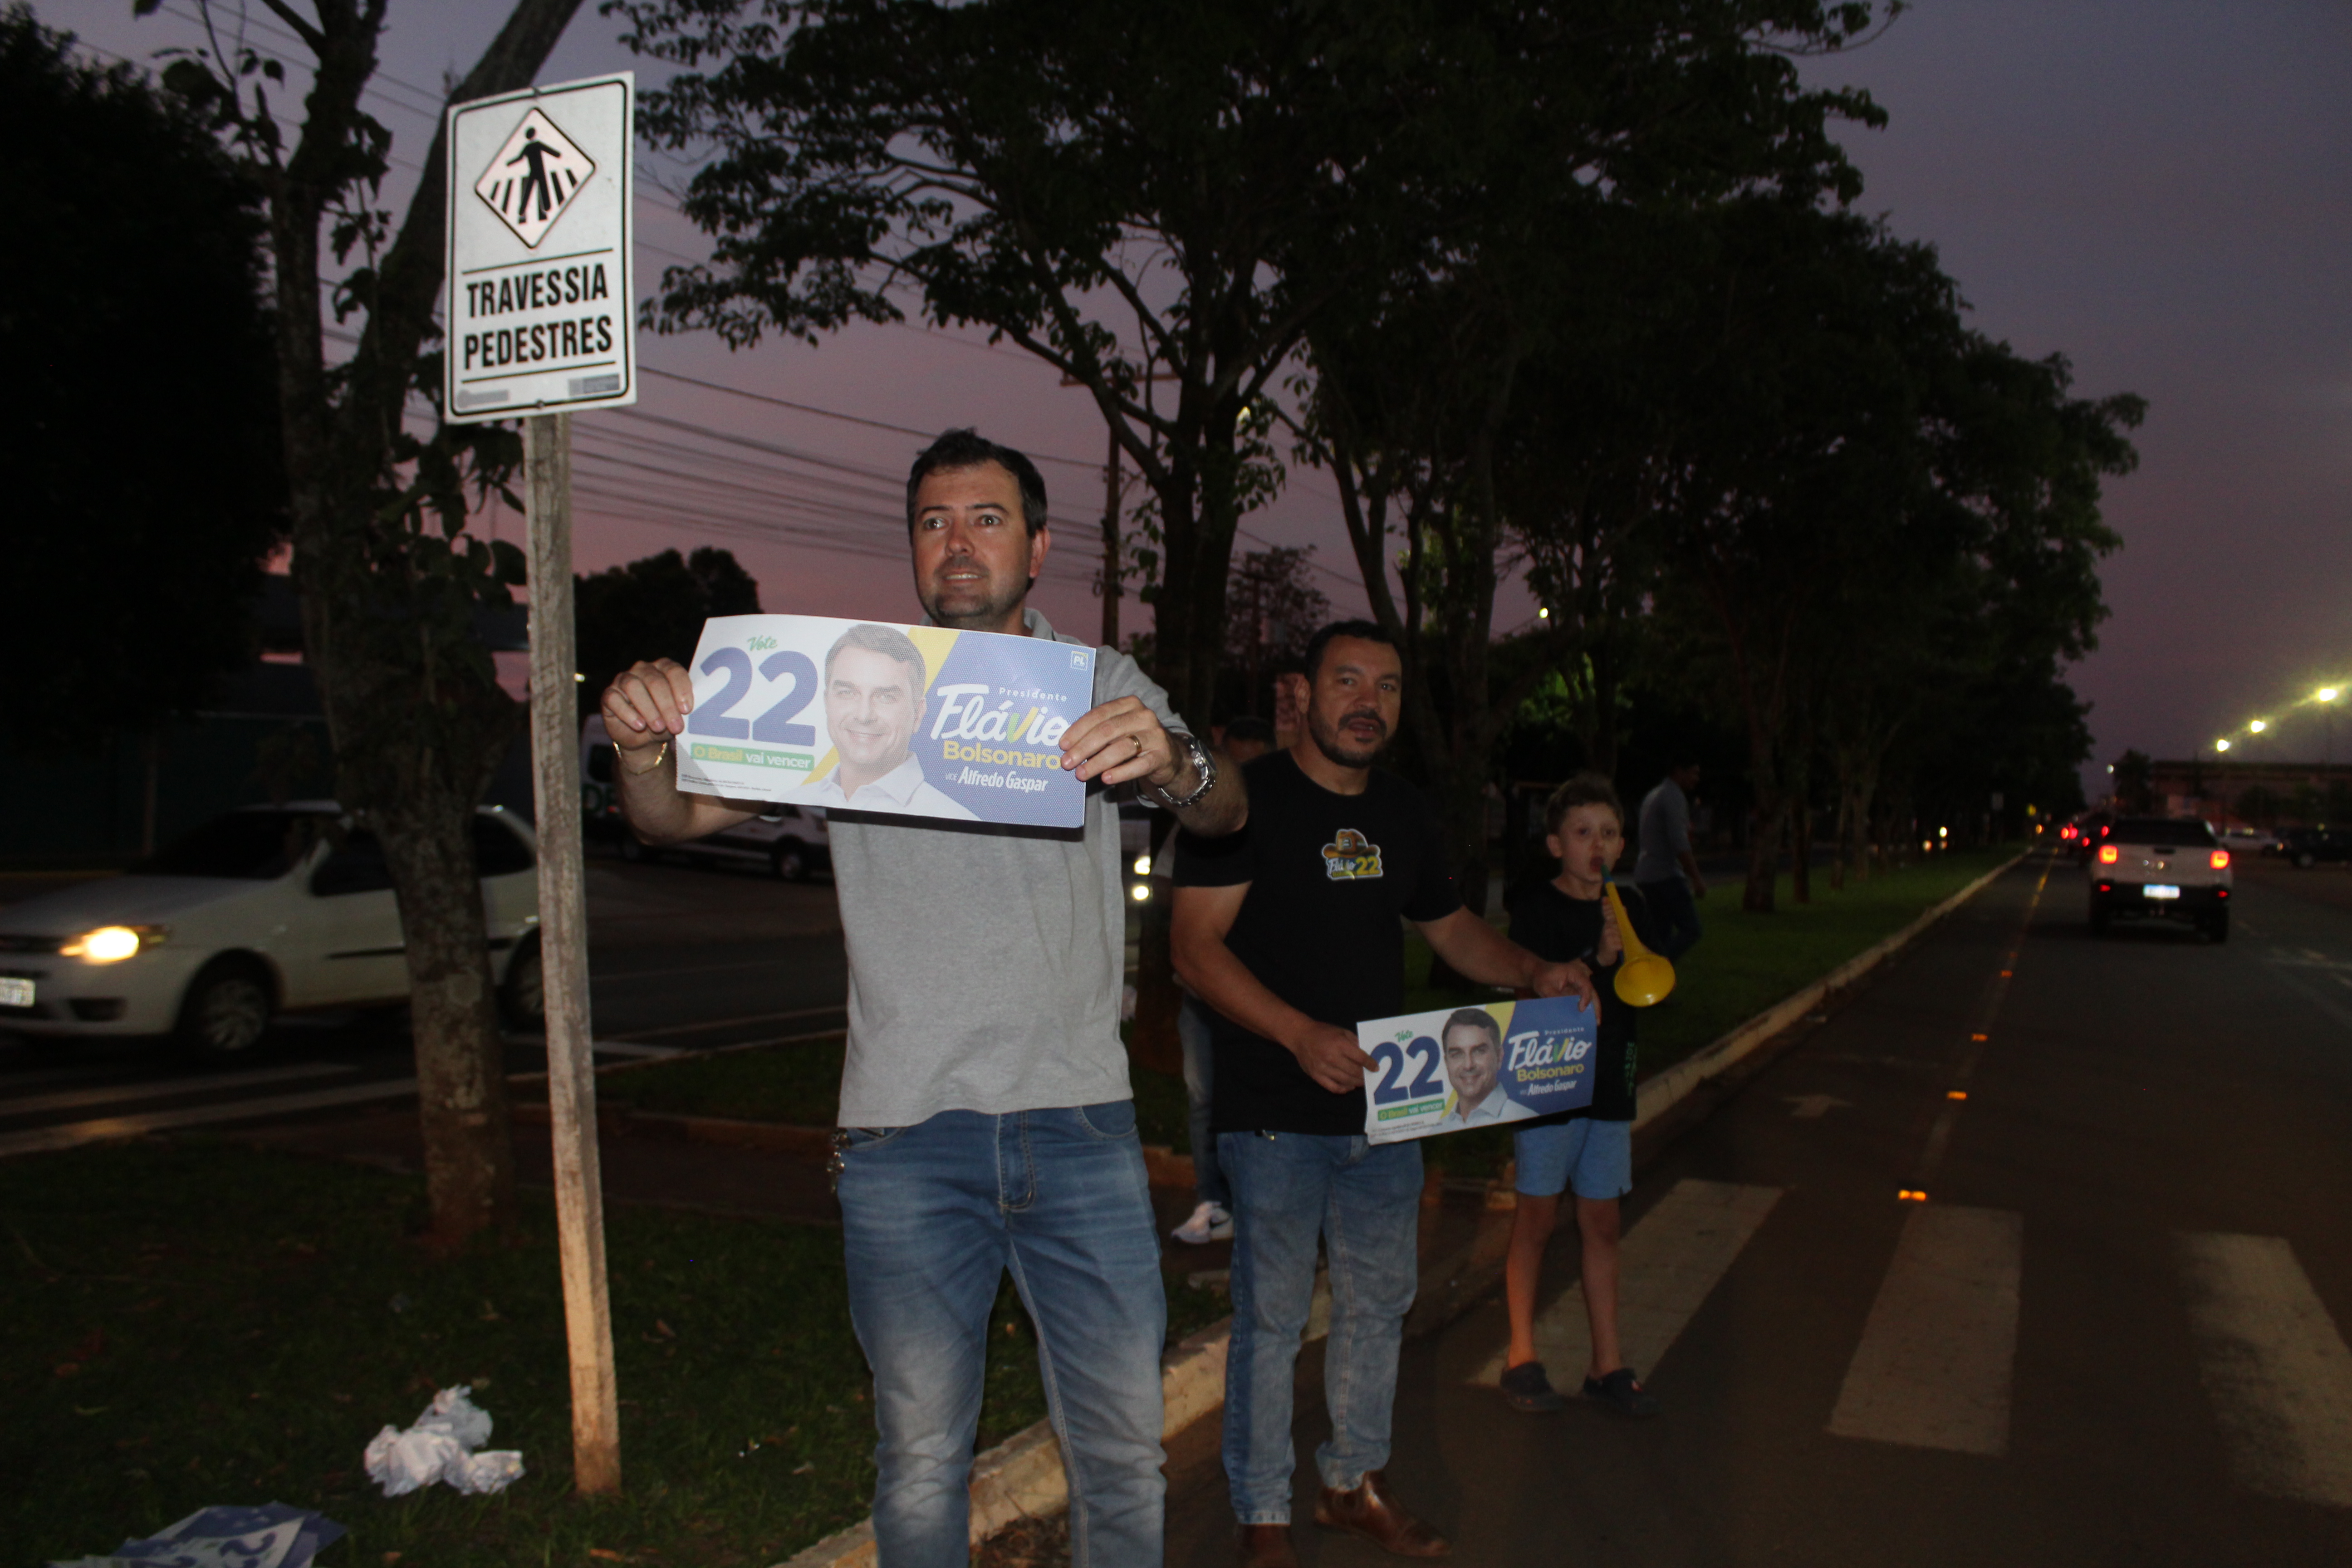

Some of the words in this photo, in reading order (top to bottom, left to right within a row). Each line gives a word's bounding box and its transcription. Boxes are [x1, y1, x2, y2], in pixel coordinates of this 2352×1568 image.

[466, 263, 608, 318] TRAVESSIA
[464, 315, 612, 370] PEDESTRES
[747, 636, 778, 651] Vote
[1074, 656, 1085, 666] PL
[688, 647, 818, 746] 22
[1000, 687, 1067, 701] Presidente
[931, 684, 1067, 746] Flávio
[708, 748, 743, 761] Brasil
[746, 753, 764, 764] vai
[766, 755, 811, 768] vencer
[944, 740, 1061, 769] Bolsonaro
[958, 766, 1004, 788] Alfredo
[1006, 771, 1049, 793] Gaspar
[1355, 856, 1380, 875] 22
[1395, 1030, 1413, 1042] Vote
[1508, 1030, 1592, 1071] Flávio
[1371, 1036, 1444, 1105] 22
[1517, 1063, 1585, 1082] Bolsonaro
[1420, 1102, 1443, 1112] vencer
